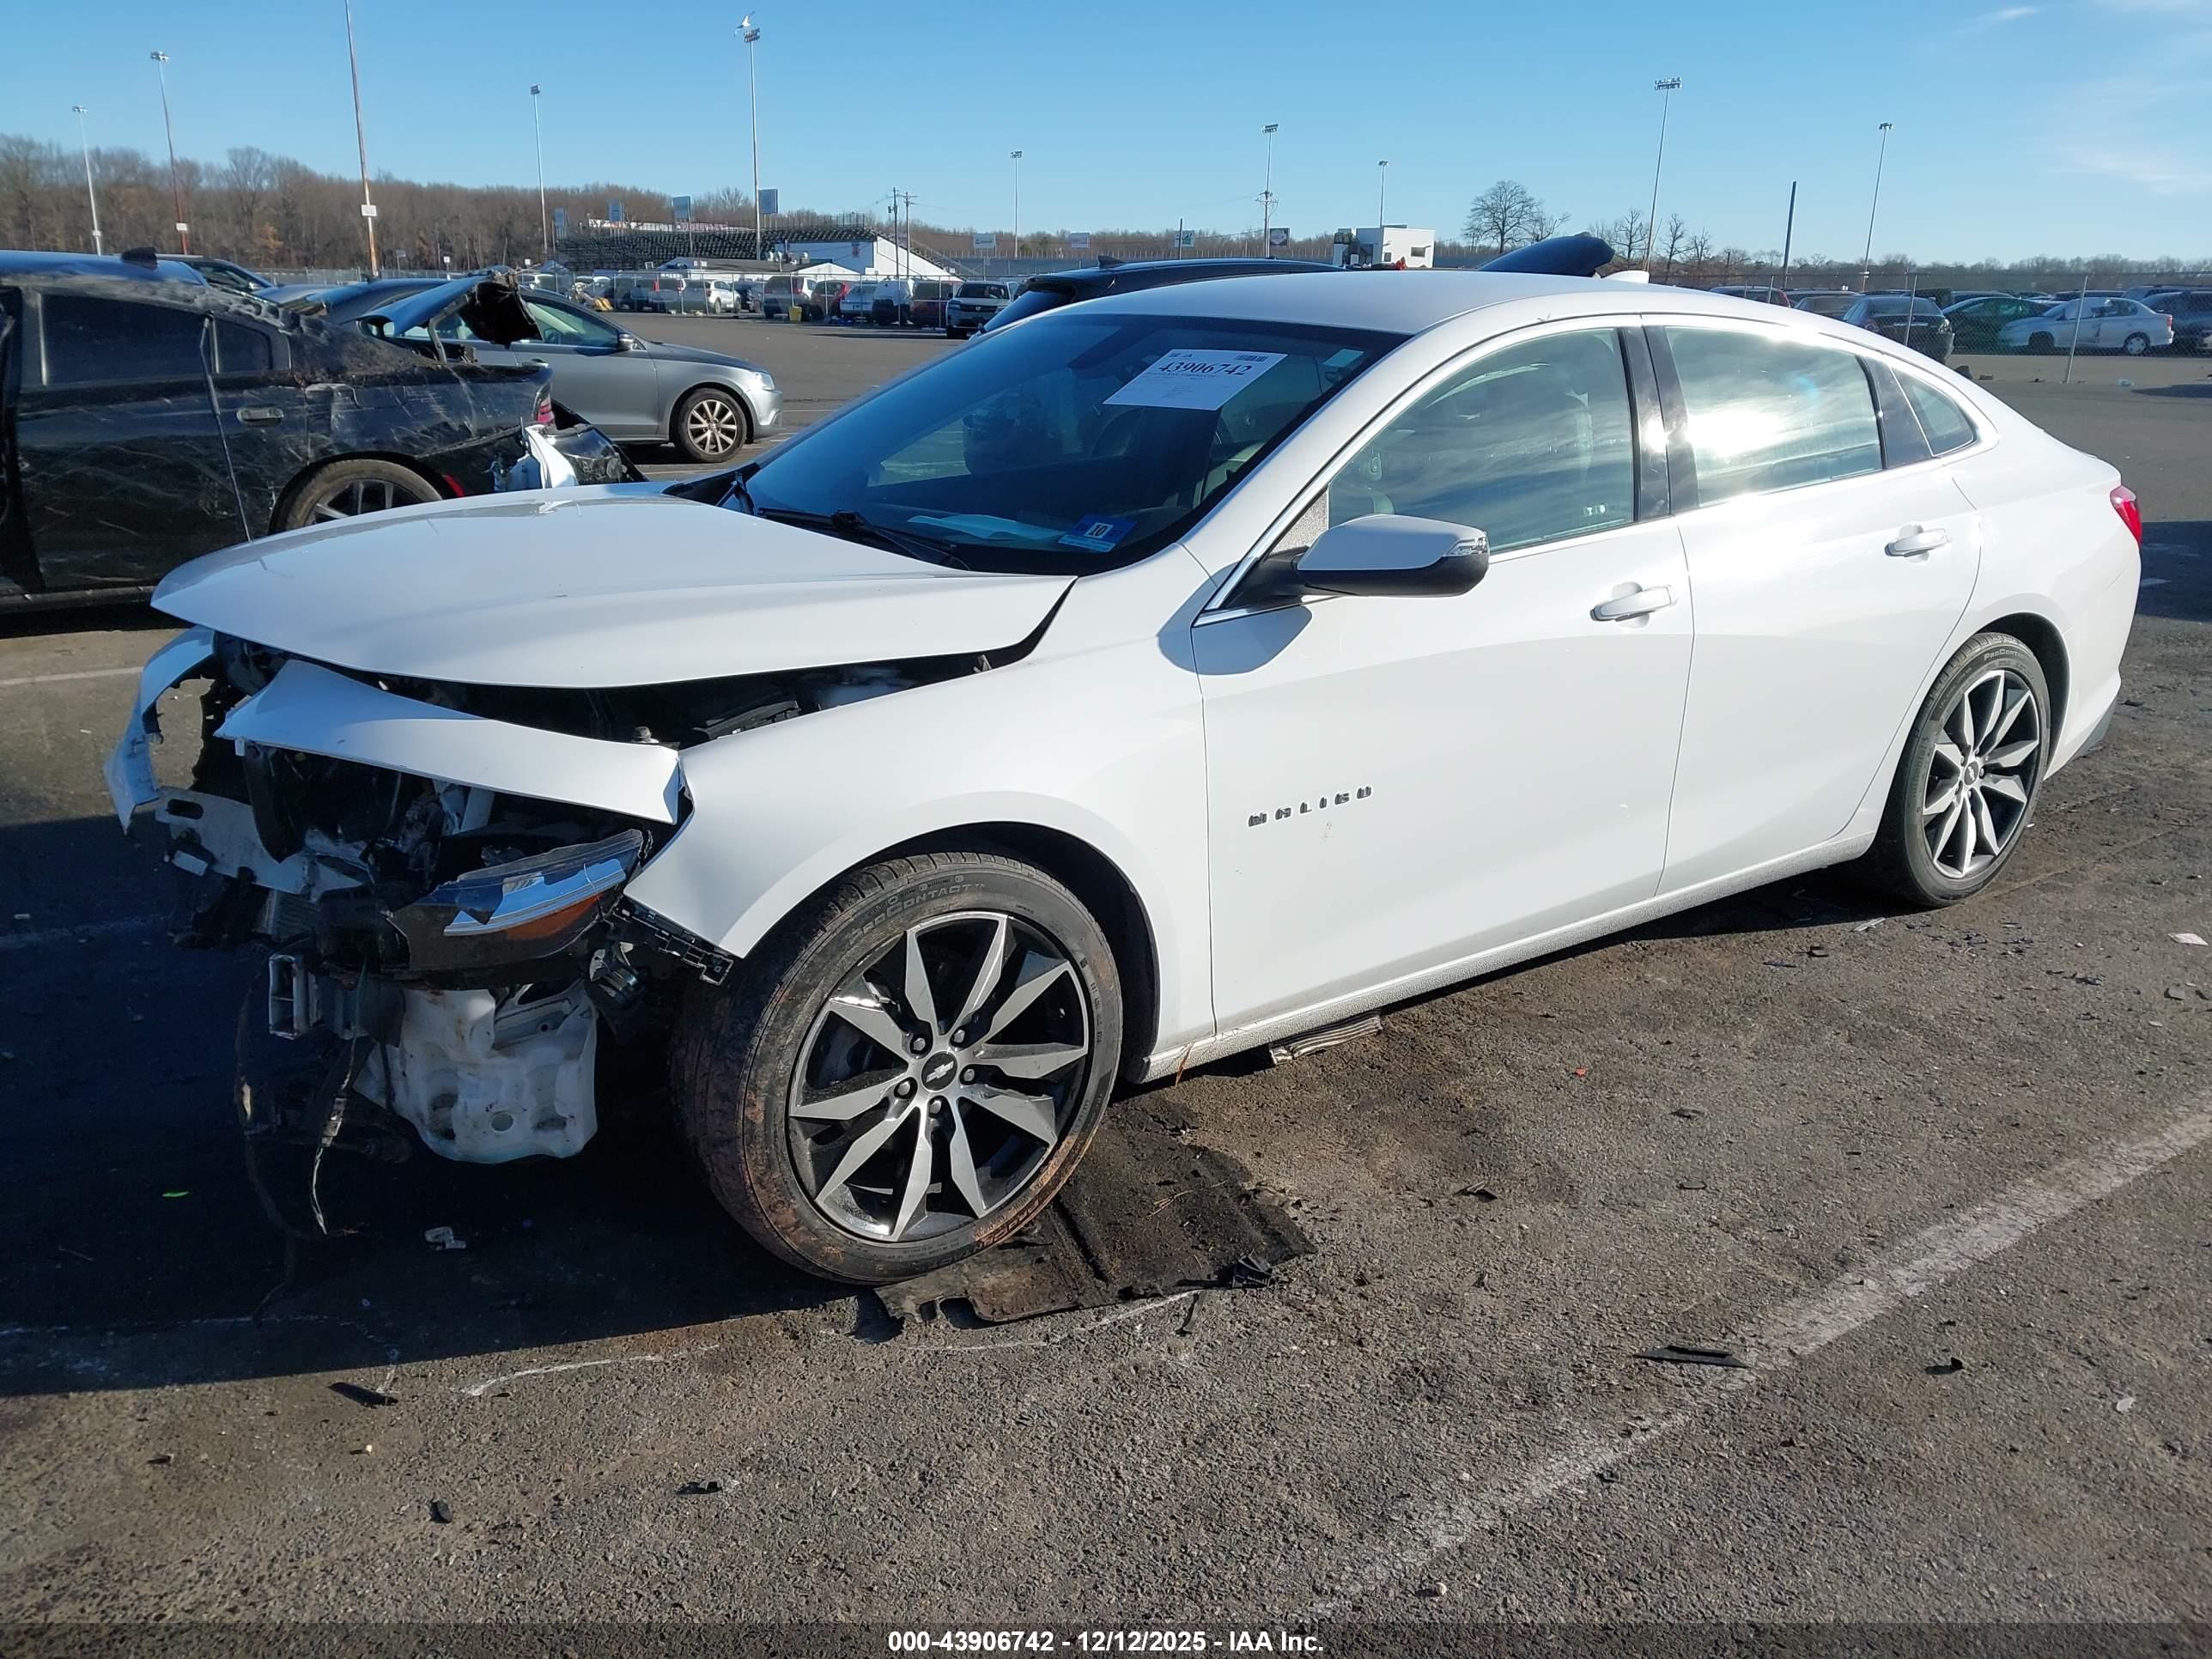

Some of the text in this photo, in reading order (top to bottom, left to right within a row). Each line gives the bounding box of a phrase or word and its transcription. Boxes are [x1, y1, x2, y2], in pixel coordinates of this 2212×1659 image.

[1158, 361, 1253, 376] 43906742
[1088, 524, 1108, 538] 10
[1248, 785, 1372, 827] MALIBU
